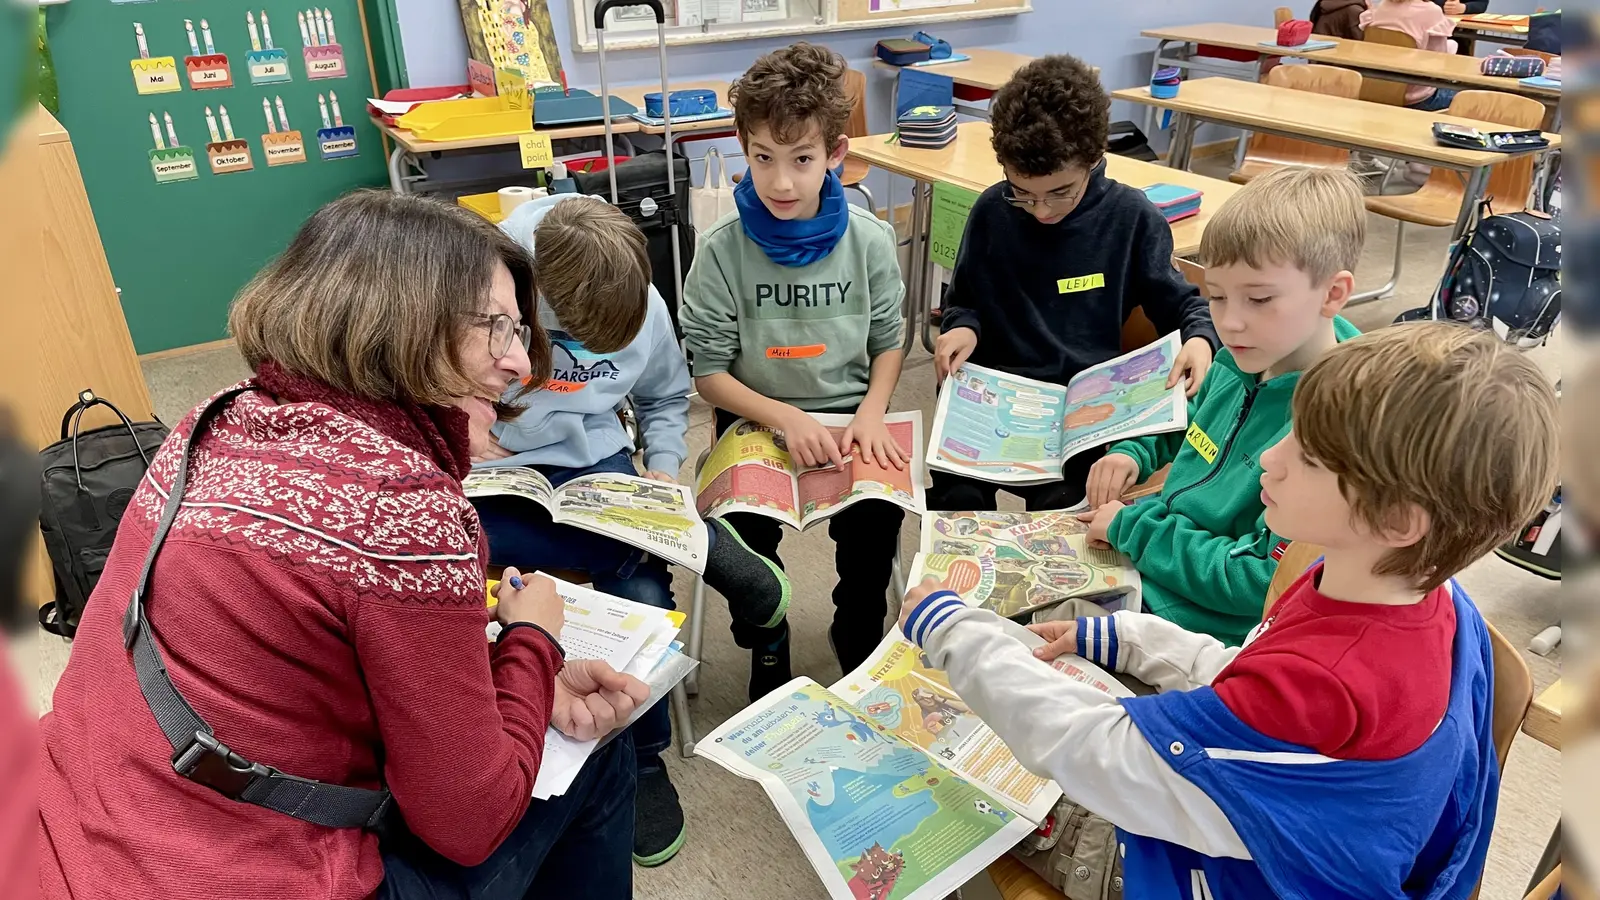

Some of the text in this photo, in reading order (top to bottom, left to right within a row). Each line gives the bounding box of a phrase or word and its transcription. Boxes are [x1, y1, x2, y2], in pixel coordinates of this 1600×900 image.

[264, 66, 275, 74] Juli
[314, 61, 337, 71] August
[150, 74, 164, 83] Mai
[203, 71, 217, 80] Juni
[323, 141, 354, 151] Dezember
[526, 140, 546, 149] chat
[268, 146, 300, 156] November
[216, 155, 245, 165] Oktober
[526, 152, 549, 165] point
[156, 163, 191, 174] September
[933, 241, 956, 260] 0123
[1066, 276, 1095, 290] LEVI
[755, 281, 852, 307] PURITY
[1187, 429, 1217, 457] ARVIN
[740, 445, 763, 453] BIB
[762, 458, 784, 470] BIB
[646, 533, 687, 551] SAUBERE
[741, 736, 752, 744] du
[753, 727, 764, 737] am
[791, 703, 799, 713] in
[727, 729, 745, 742] Was
[744, 741, 767, 757] deiner
